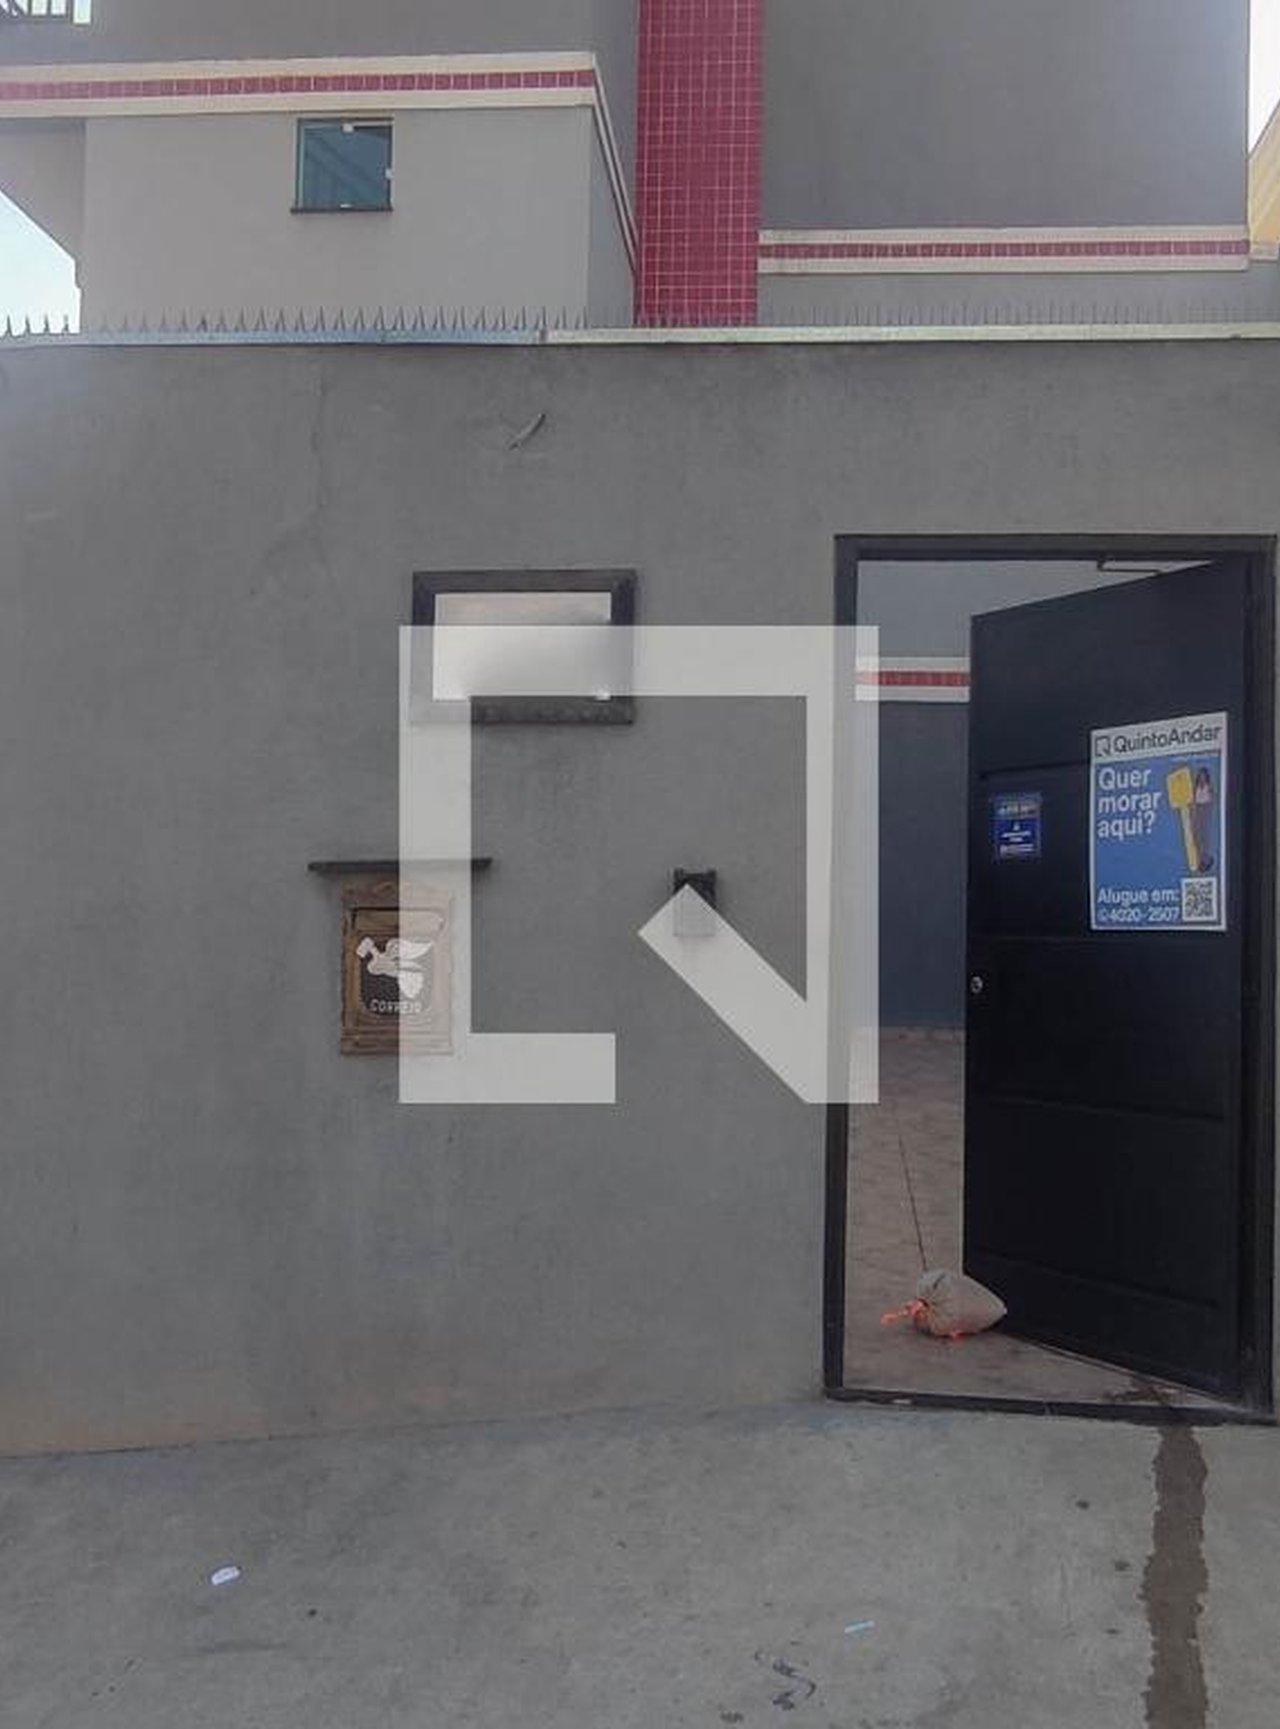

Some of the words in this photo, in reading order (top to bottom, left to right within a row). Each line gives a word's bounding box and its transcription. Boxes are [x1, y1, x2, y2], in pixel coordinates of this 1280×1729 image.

[1114, 724, 1222, 753] QuintoAndar
[1099, 768, 1151, 790] Quer
[1098, 792, 1161, 814] morar
[1097, 810, 1156, 840] aqui?
[1098, 887, 1149, 907] Alugue
[1151, 889, 1180, 903] em:
